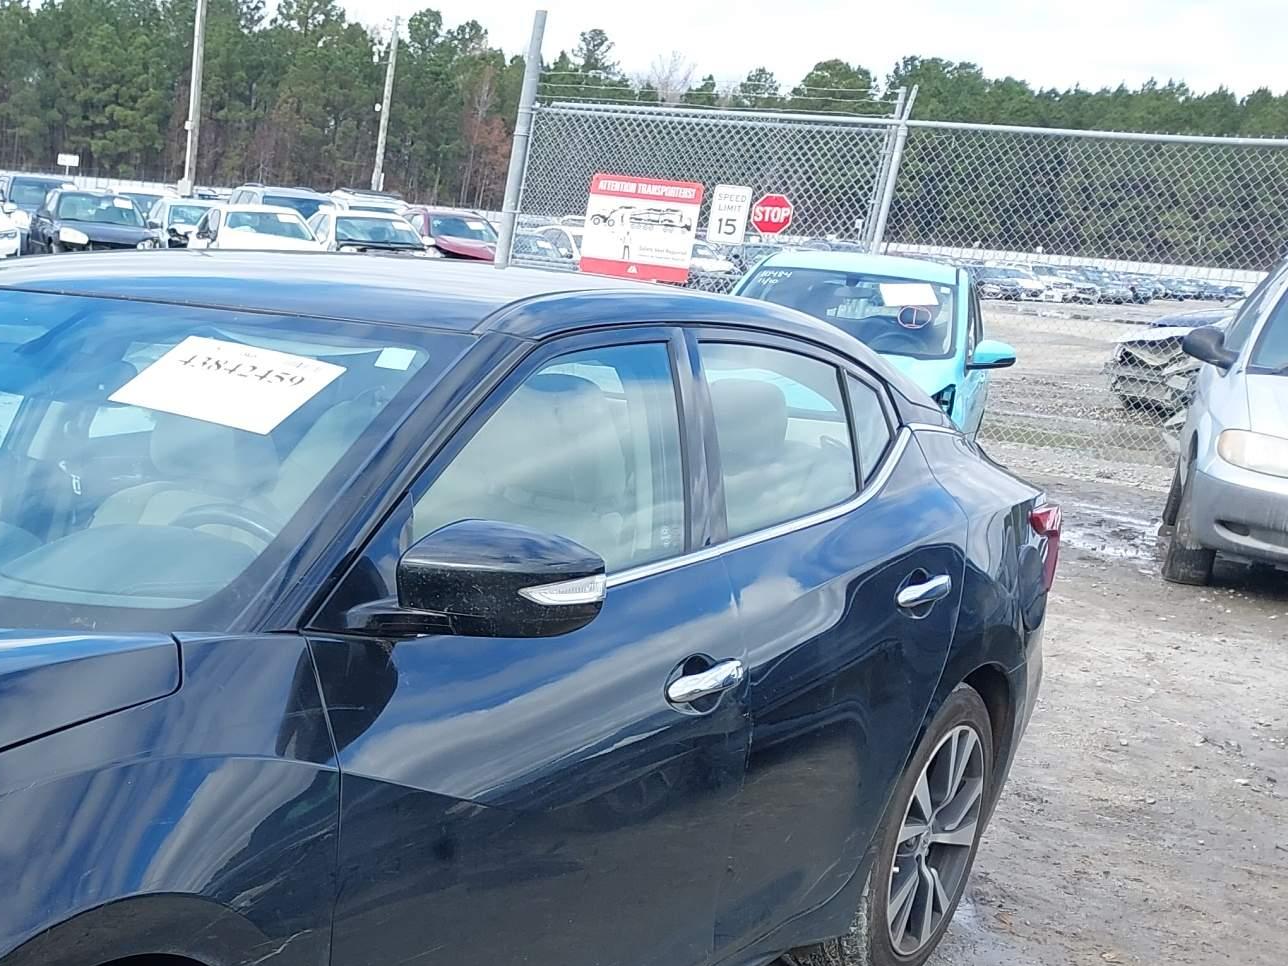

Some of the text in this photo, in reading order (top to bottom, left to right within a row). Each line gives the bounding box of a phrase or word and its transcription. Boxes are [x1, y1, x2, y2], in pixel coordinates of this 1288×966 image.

[598, 180, 636, 193] ATTENTION
[718, 192, 747, 202] SPEED
[718, 203, 743, 212] LIMIT
[753, 206, 791, 223] STOP
[718, 217, 737, 235] 15
